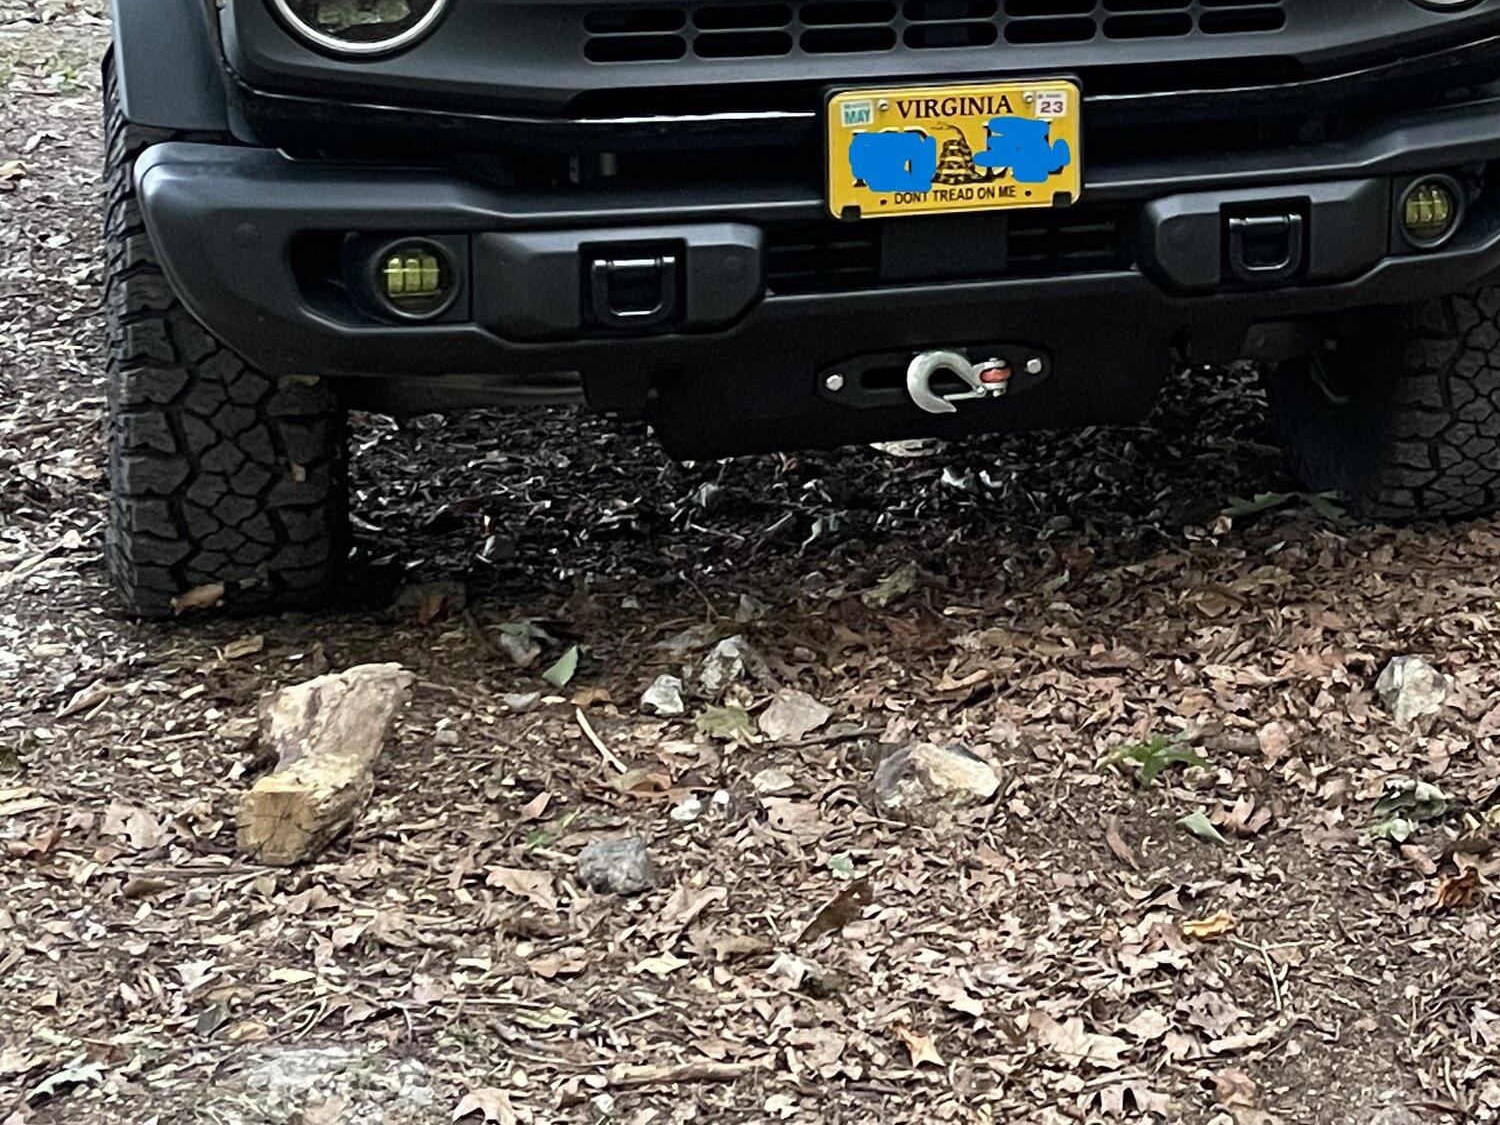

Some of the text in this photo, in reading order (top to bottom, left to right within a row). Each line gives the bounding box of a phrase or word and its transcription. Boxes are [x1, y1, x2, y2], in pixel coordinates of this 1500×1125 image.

[897, 95, 1013, 119] VIRGINIA
[1040, 101, 1063, 113] 23
[844, 109, 870, 124] MAY
[894, 185, 1016, 205] DONT TREAD ON ME
